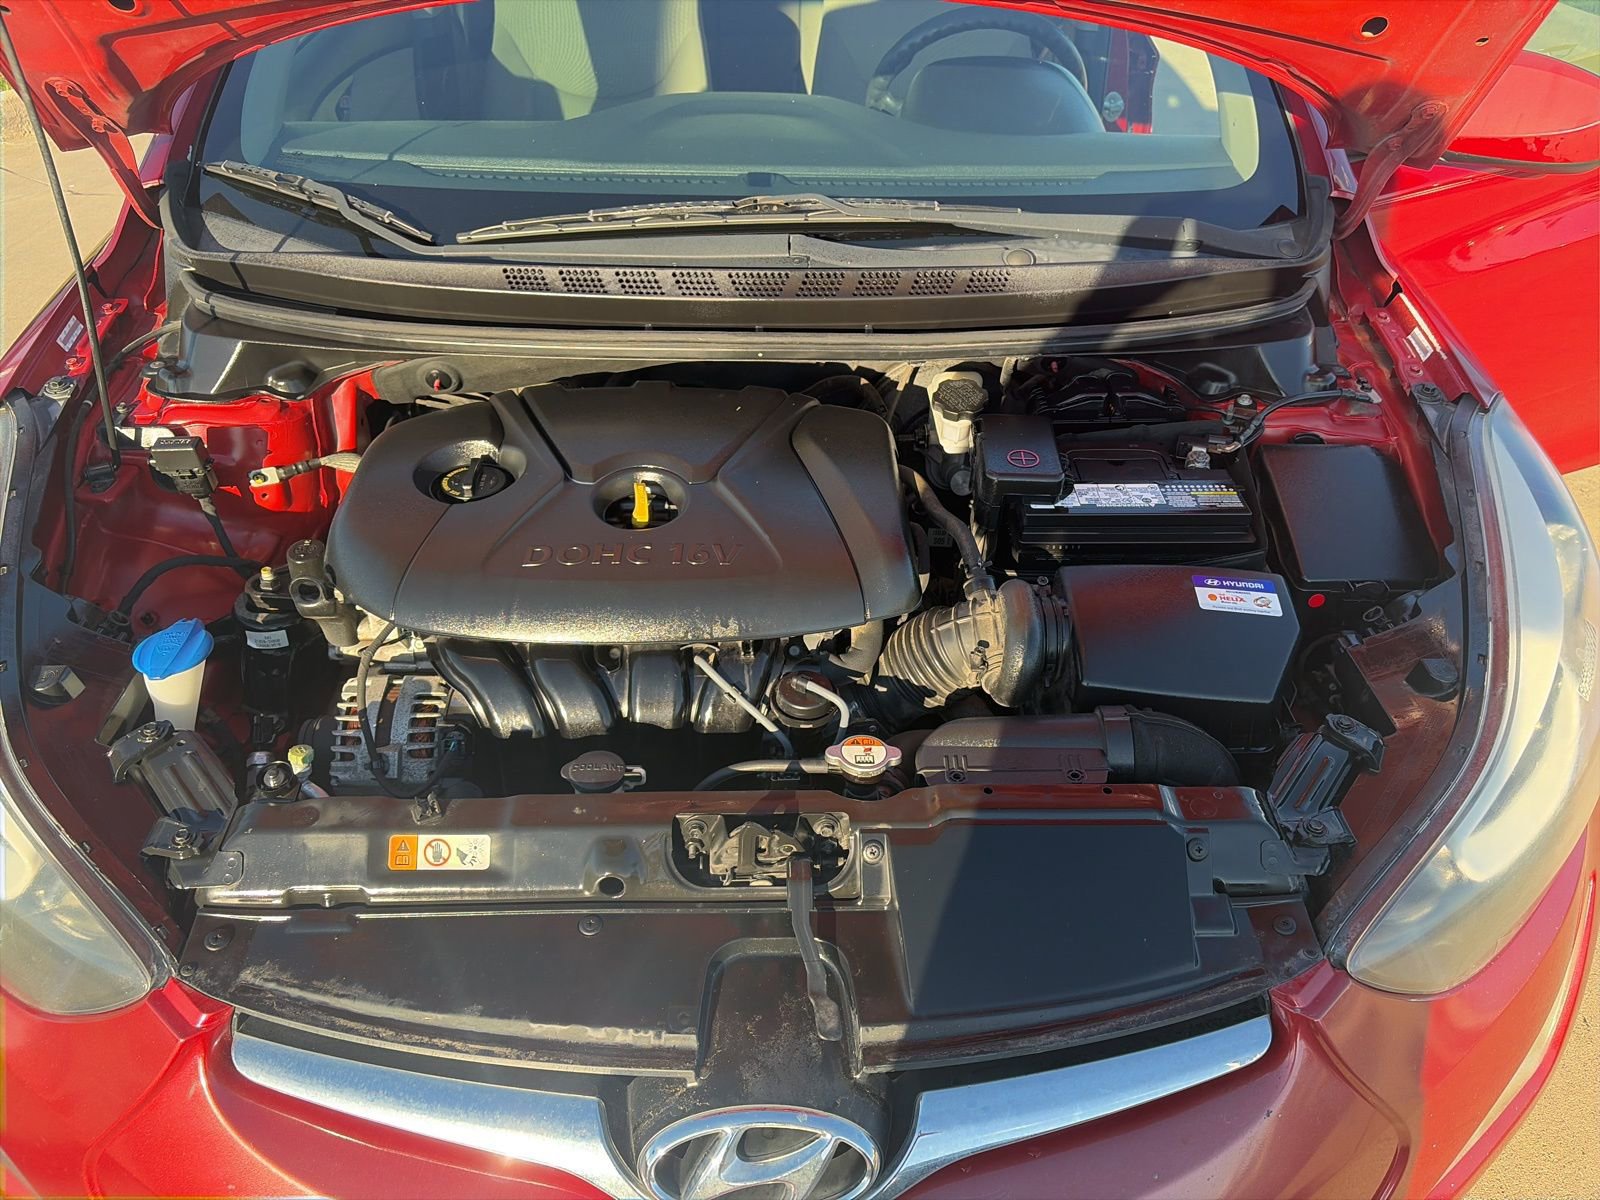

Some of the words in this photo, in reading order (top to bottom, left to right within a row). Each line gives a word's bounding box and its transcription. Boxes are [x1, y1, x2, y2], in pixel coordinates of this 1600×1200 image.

[521, 542, 652, 568] DOHC
[669, 542, 744, 566] 16V
[1222, 580, 1264, 589] HYUNDAI
[1219, 595, 1247, 603] HELIX
[572, 763, 624, 772] COOLANT
